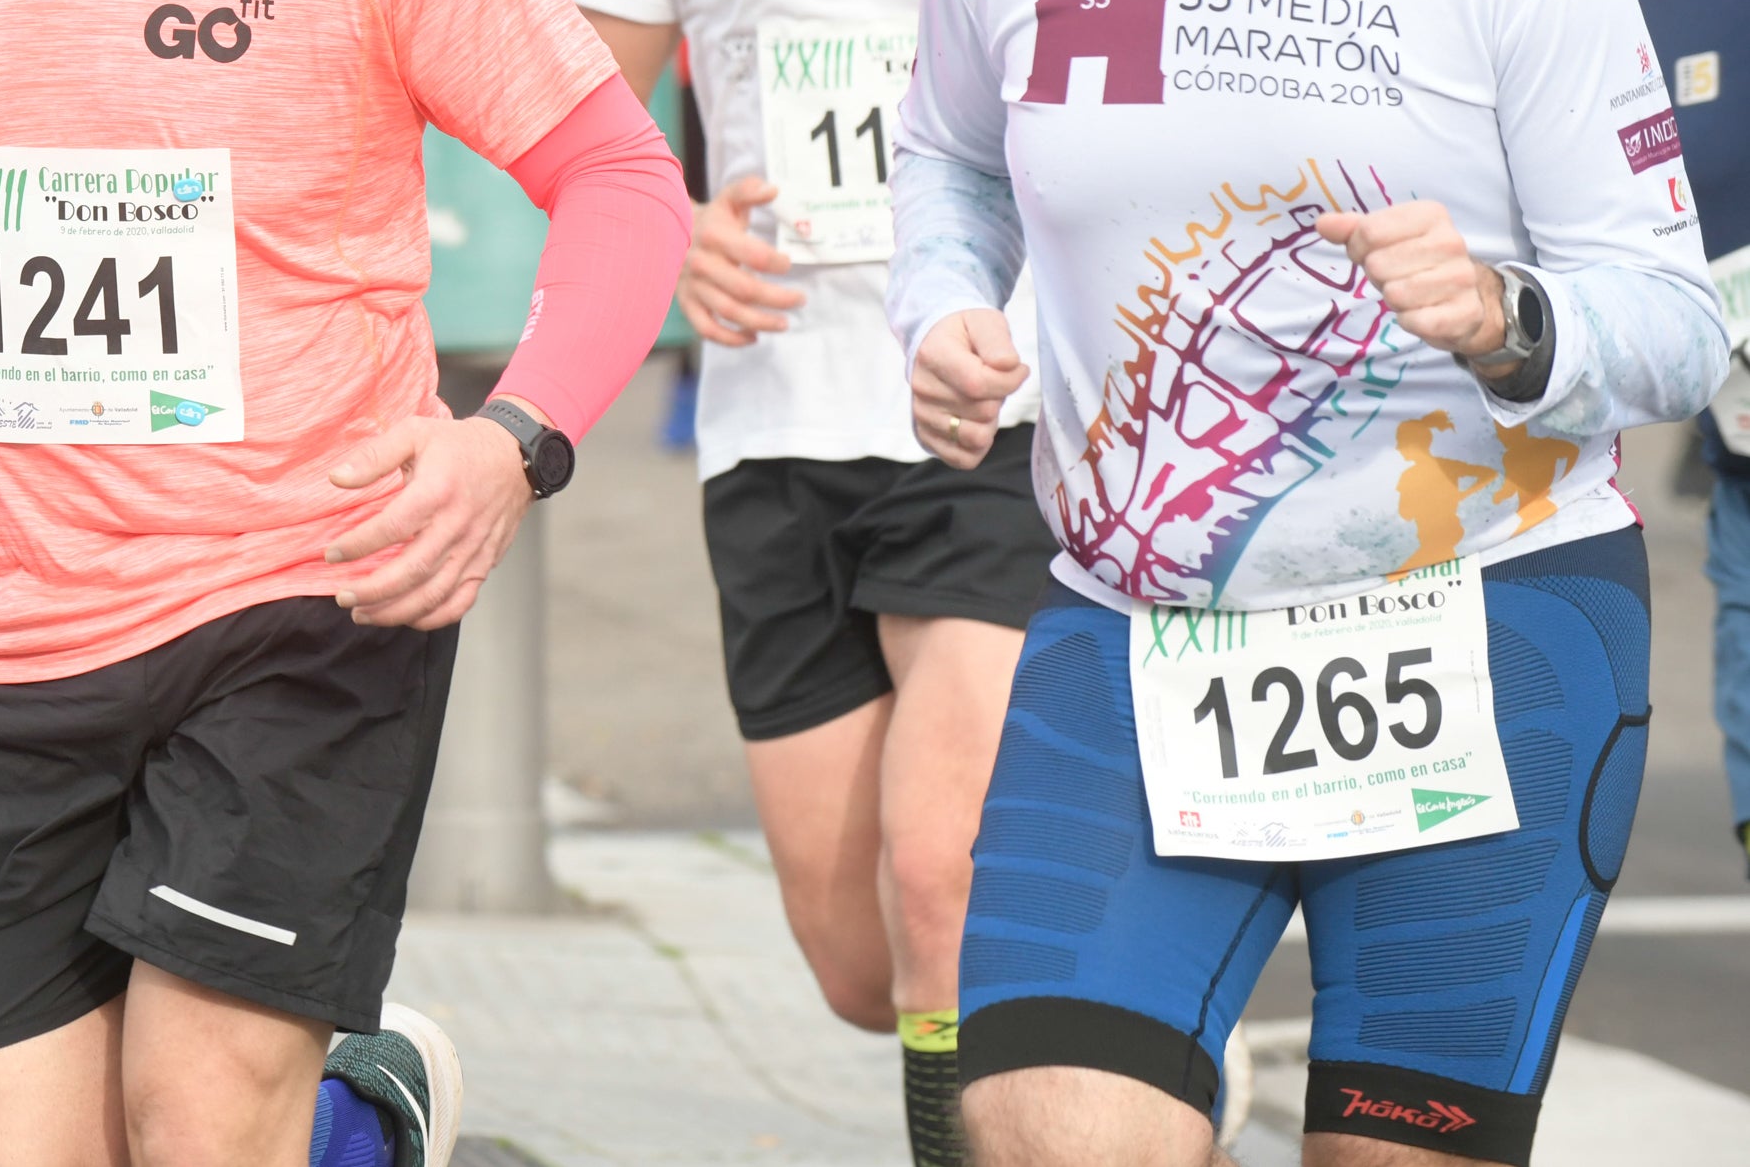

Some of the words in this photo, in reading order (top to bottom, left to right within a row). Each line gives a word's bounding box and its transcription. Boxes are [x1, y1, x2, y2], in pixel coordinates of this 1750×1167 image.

[144, 3, 252, 64] GO
[1175, 25, 1400, 76] MARATÓN
[773, 38, 854, 92] XXIII
[1173, 65, 1325, 103] CÓRDOBA
[1331, 84, 1403, 107] 2019
[39, 166, 117, 194] Carrera
[45, 195, 109, 222] "Don
[118, 195, 215, 222] Bosco"
[60, 226, 66, 234] 9
[67, 226, 77, 235] de
[79, 226, 111, 236] febrero
[114, 227, 124, 236] de
[126, 226, 149, 237] 2020,
[151, 224, 195, 235] Valladolid
[26, 369, 40, 382] en
[45, 367, 56, 382] el
[61, 367, 106, 383] barrio,
[111, 370, 148, 382] como
[153, 369, 169, 382] en
[174, 365, 214, 381] casa”
[1358, 580, 1462, 616] Bosco"
[1143, 604, 1247, 669] XXIII
[1194, 647, 1443, 779] 1265
[1272, 789, 1289, 801] en
[1295, 782, 1308, 798] el
[1313, 774, 1363, 796] barrio,
[1367, 767, 1407, 787] como
[1411, 764, 1428, 778] en
[1433, 751, 1472, 774] casa”
